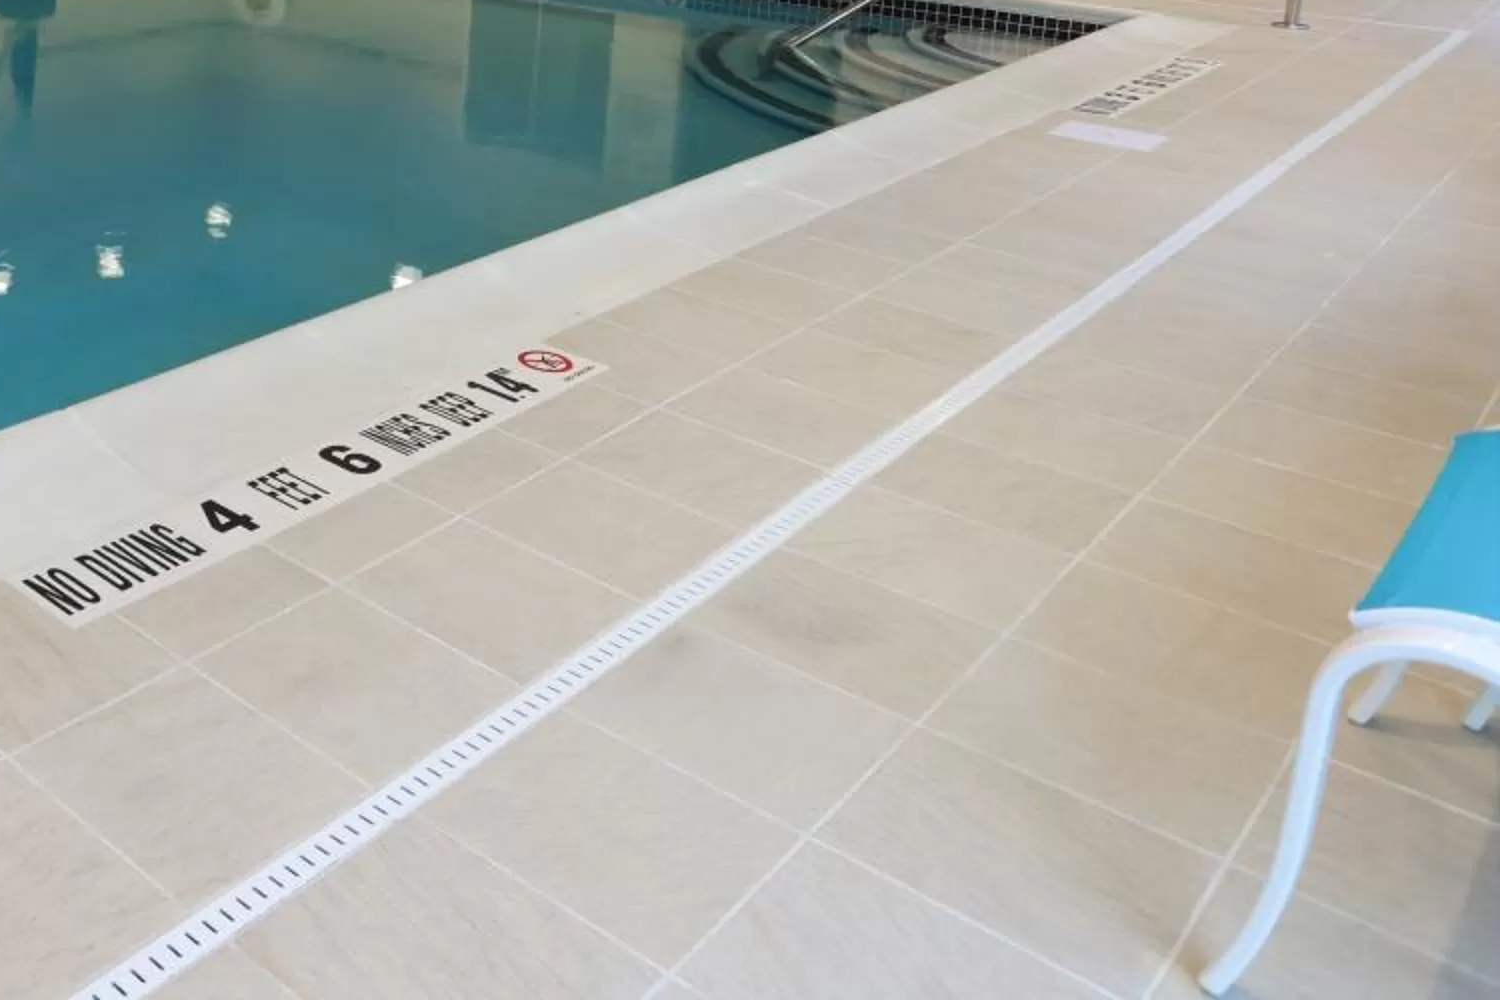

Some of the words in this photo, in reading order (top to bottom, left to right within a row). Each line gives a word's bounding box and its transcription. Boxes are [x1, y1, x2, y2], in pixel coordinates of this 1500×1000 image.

[22, 567, 102, 616] NO
[74, 523, 208, 592] DIVING
[200, 499, 260, 533] 4
[247, 466, 331, 511] FEET
[318, 445, 382, 475] 6
